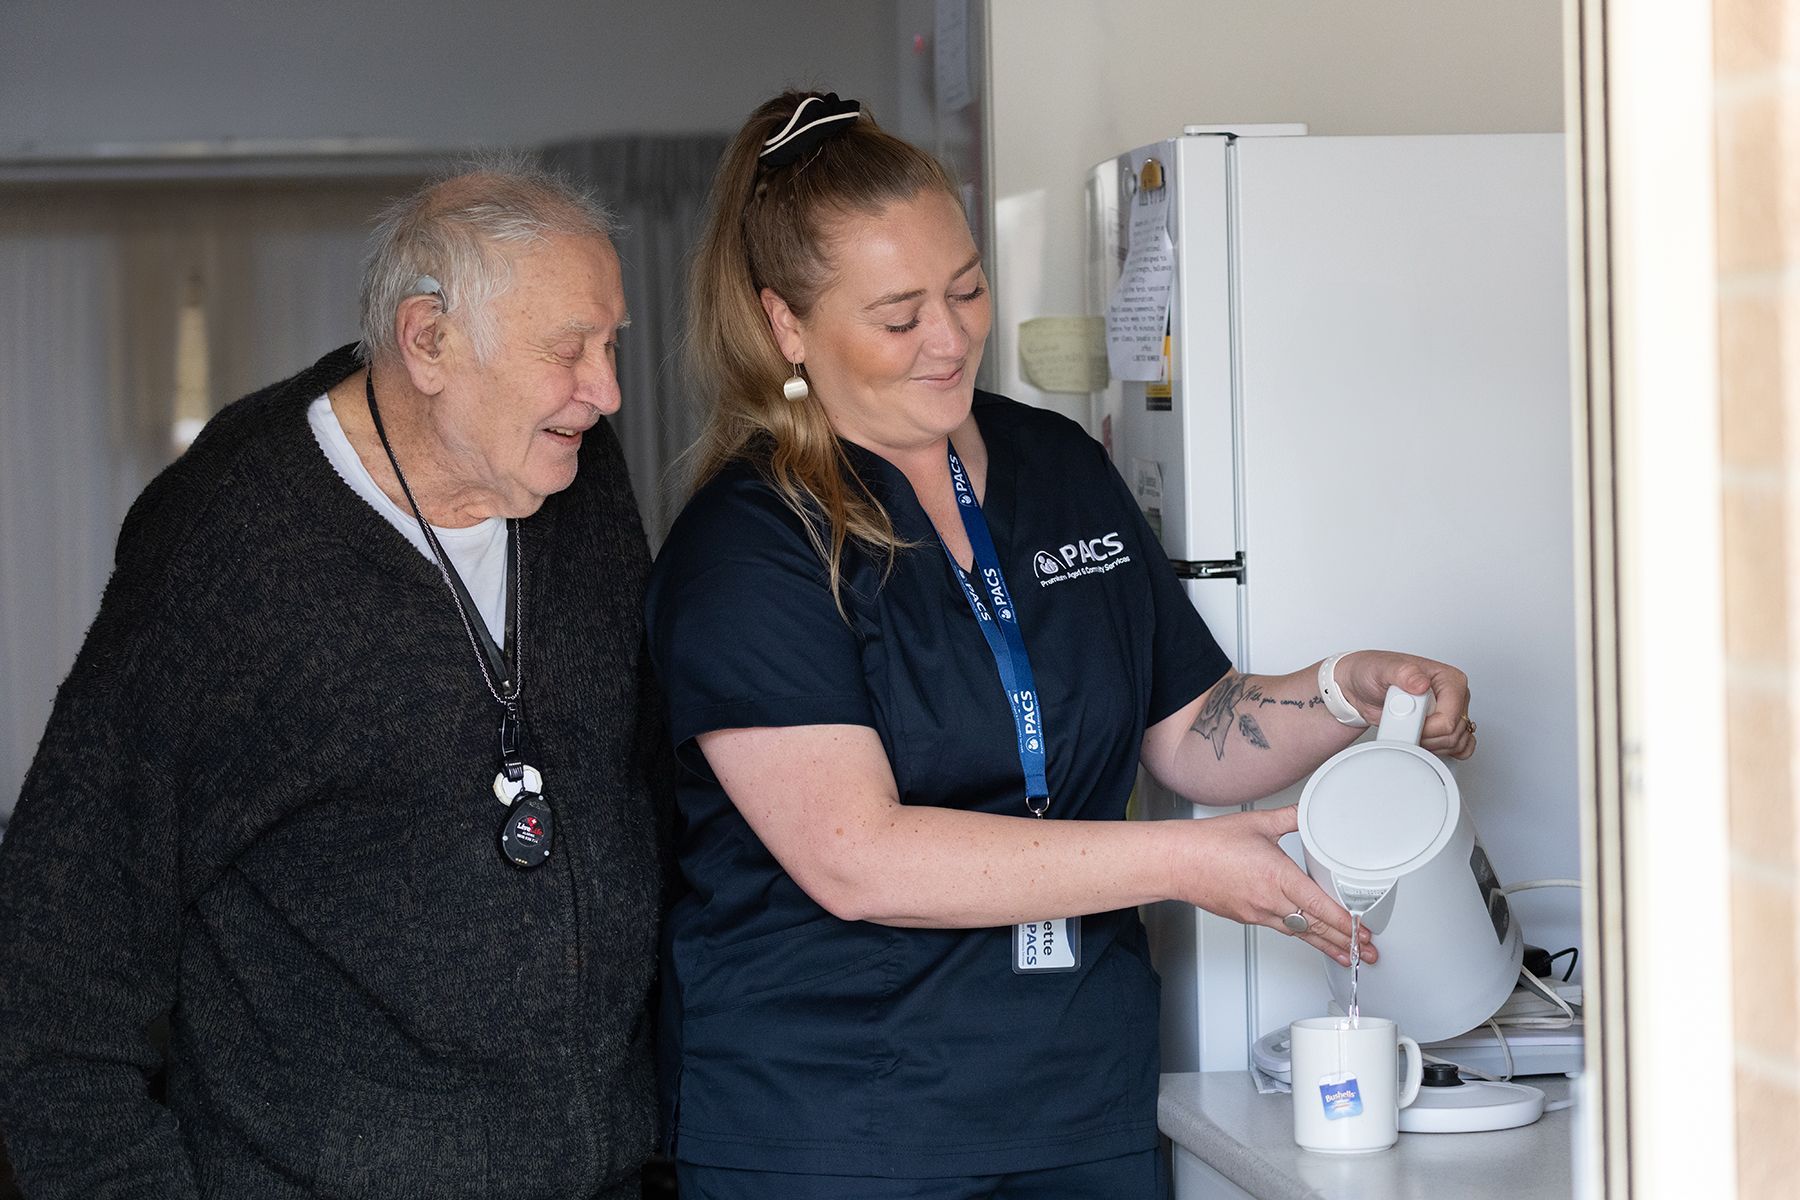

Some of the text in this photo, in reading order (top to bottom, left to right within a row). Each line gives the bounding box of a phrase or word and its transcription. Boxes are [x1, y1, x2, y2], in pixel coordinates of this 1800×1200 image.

[950, 454, 968, 491] PACS
[1059, 532, 1124, 568] PACS
[984, 568, 1008, 606] PACS
[1040, 575, 1068, 588] Premium
[1067, 568, 1082, 579] Aged
[1104, 556, 1131, 572] Services
[965, 583, 992, 621] PACS
[1020, 690, 1036, 735] PACS
[1026, 924, 1037, 965] PACS
[1325, 1091, 1355, 1103] Bushells
